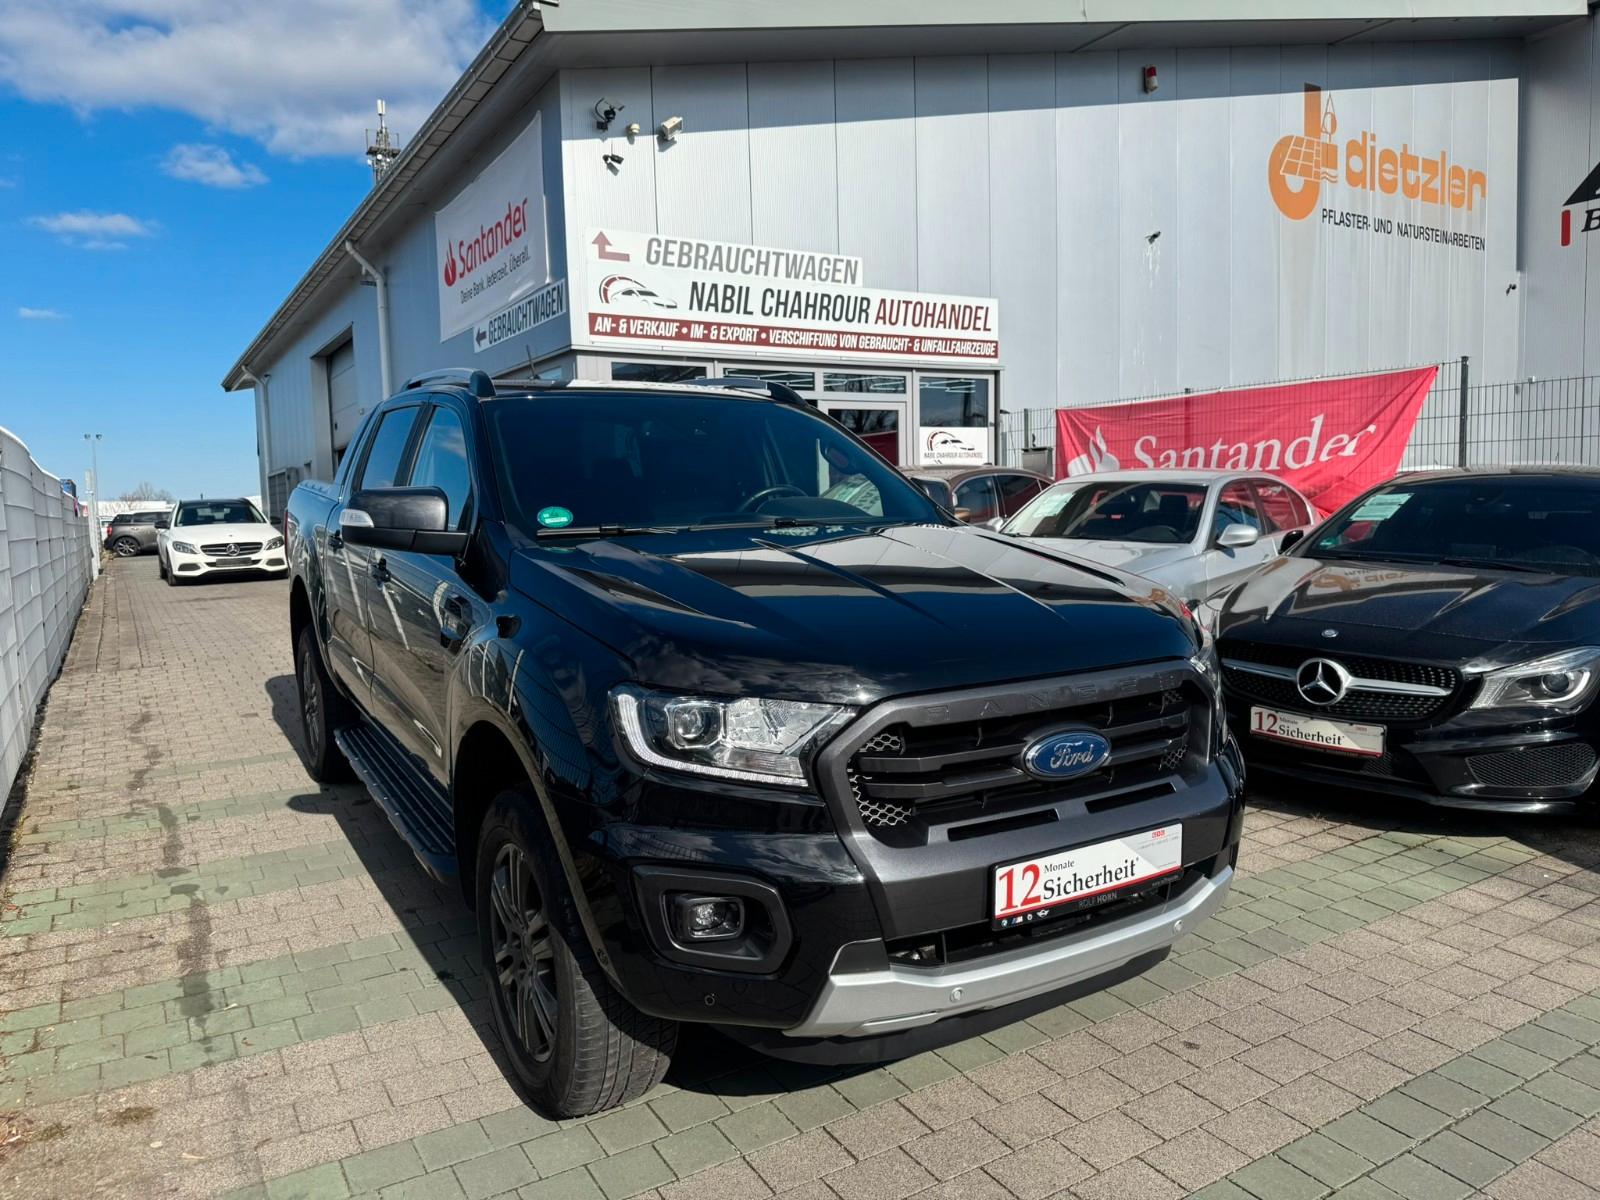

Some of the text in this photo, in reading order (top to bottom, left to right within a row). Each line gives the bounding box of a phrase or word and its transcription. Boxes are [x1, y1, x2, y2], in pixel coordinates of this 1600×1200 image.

[1345, 130, 1487, 212] dietzler
[458, 197, 528, 279] Santander
[1322, 208, 1486, 251] PFLASTER- UND NATURSTEINARBEITEN
[645, 237, 859, 285] GEBRAUCHTWAGEN
[488, 282, 564, 344] GEBRAUCHTWAGEN
[688, 281, 992, 332] NABIL CHAHROUR AUTOHANDEL
[594, 316, 996, 356] AN- & VERKAUF IM- & EXPORT VERSCHIFFUNG VON GEBRAUCHT- & UNFALLFAHRZEUGE
[1134, 413, 1377, 471] Santander
[927, 672, 1183, 721] RANGER
[1254, 711, 1278, 734] 12
[1049, 740, 1095, 770] Ford
[998, 859, 1075, 912] 12 Monate
[1096, 892, 1118, 906] HORN
